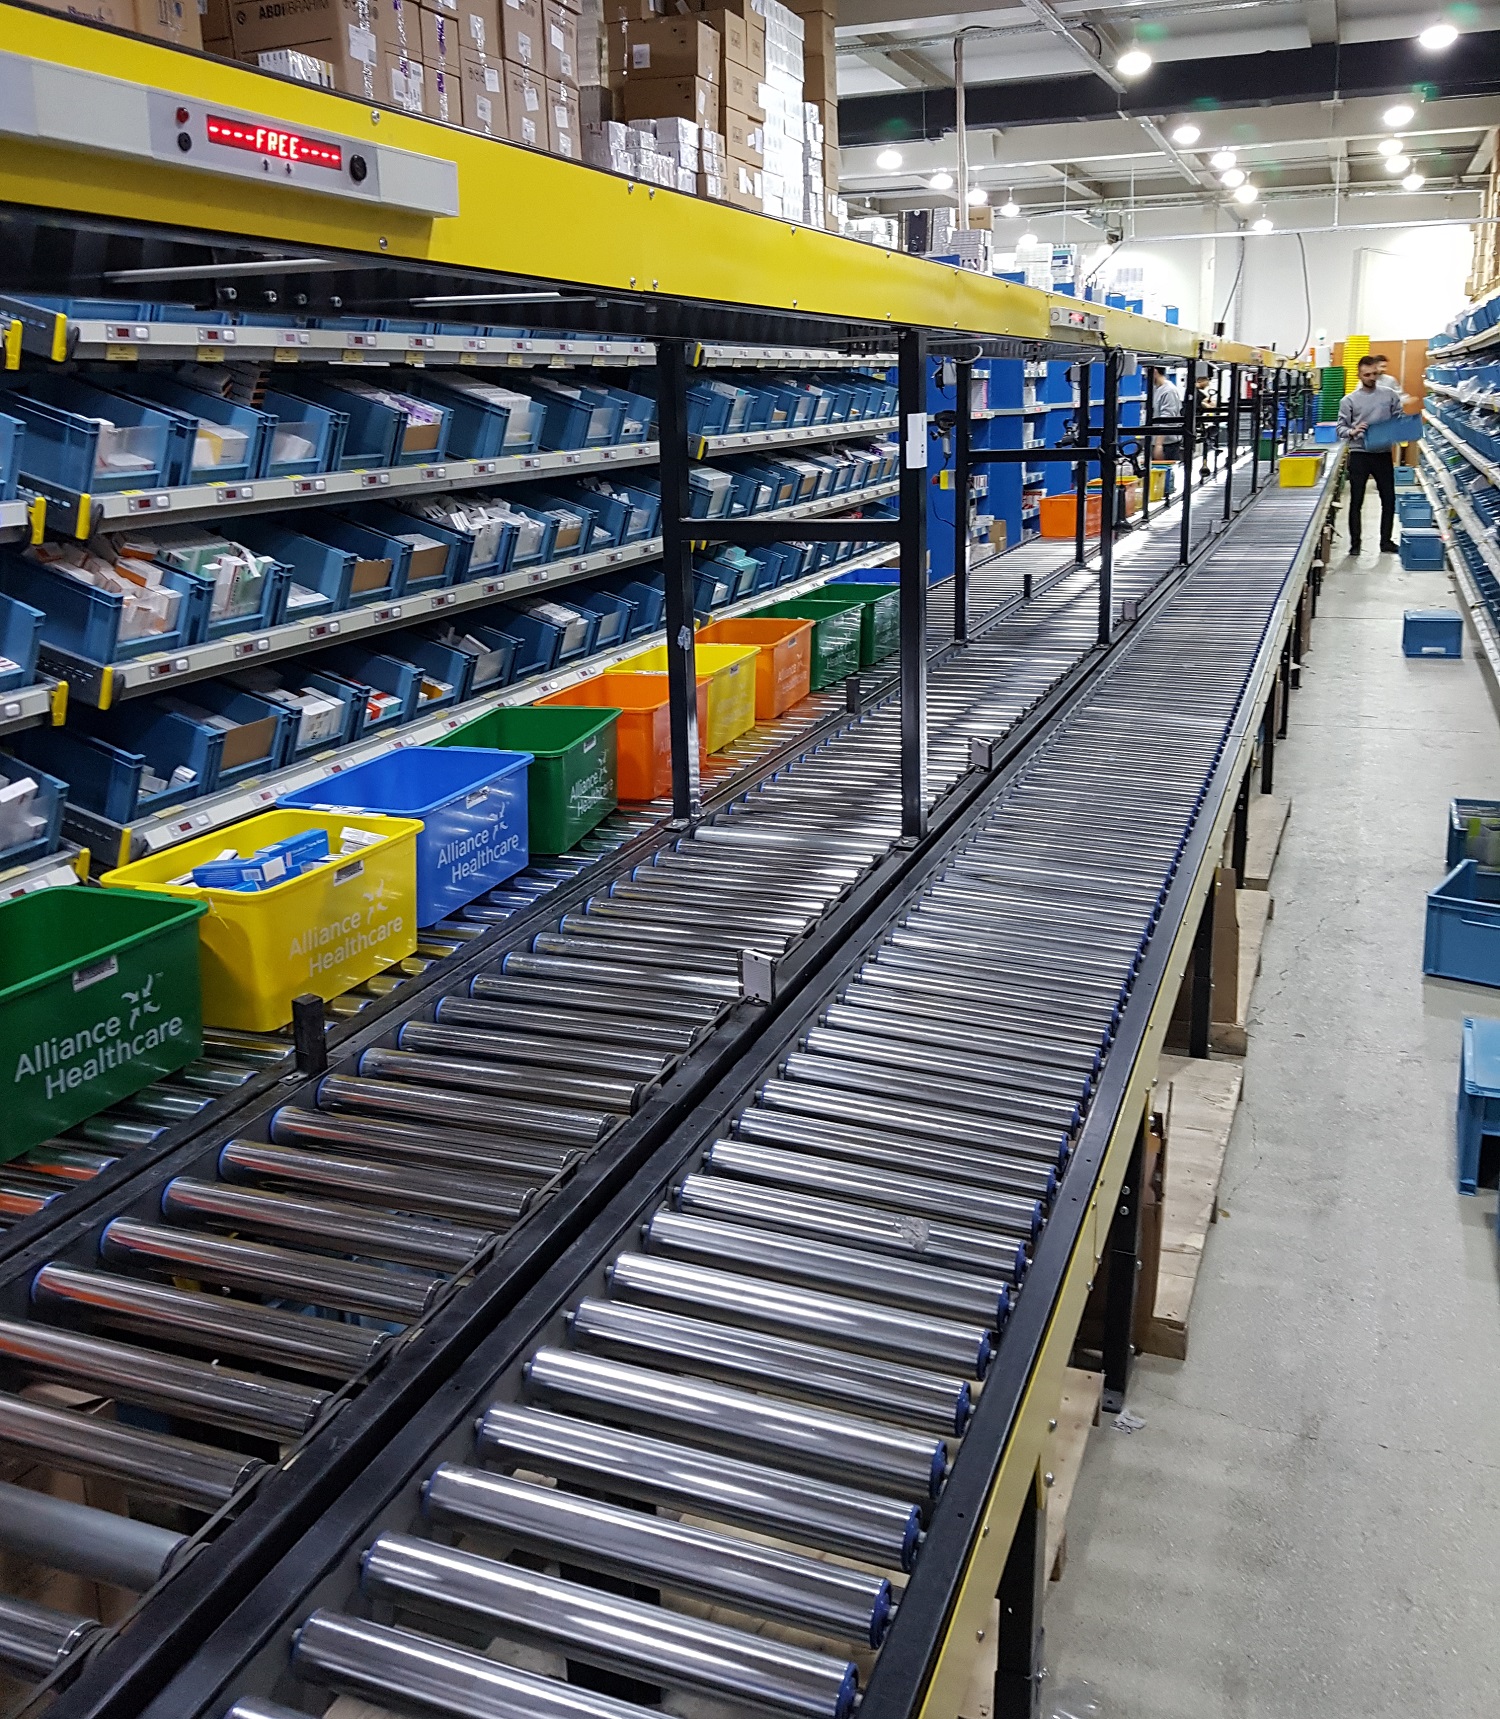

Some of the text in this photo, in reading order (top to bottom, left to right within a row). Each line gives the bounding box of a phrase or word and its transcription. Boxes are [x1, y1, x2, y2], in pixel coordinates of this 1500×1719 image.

[570, 772, 599, 804] Alliance
[437, 829, 490, 869] Alliance
[451, 834, 520, 884] Healthcare
[288, 911, 361, 960] Alliance
[309, 916, 404, 977] Healthcare
[14, 1016, 122, 1083] Alliance
[45, 1016, 184, 1100] Healthcare
